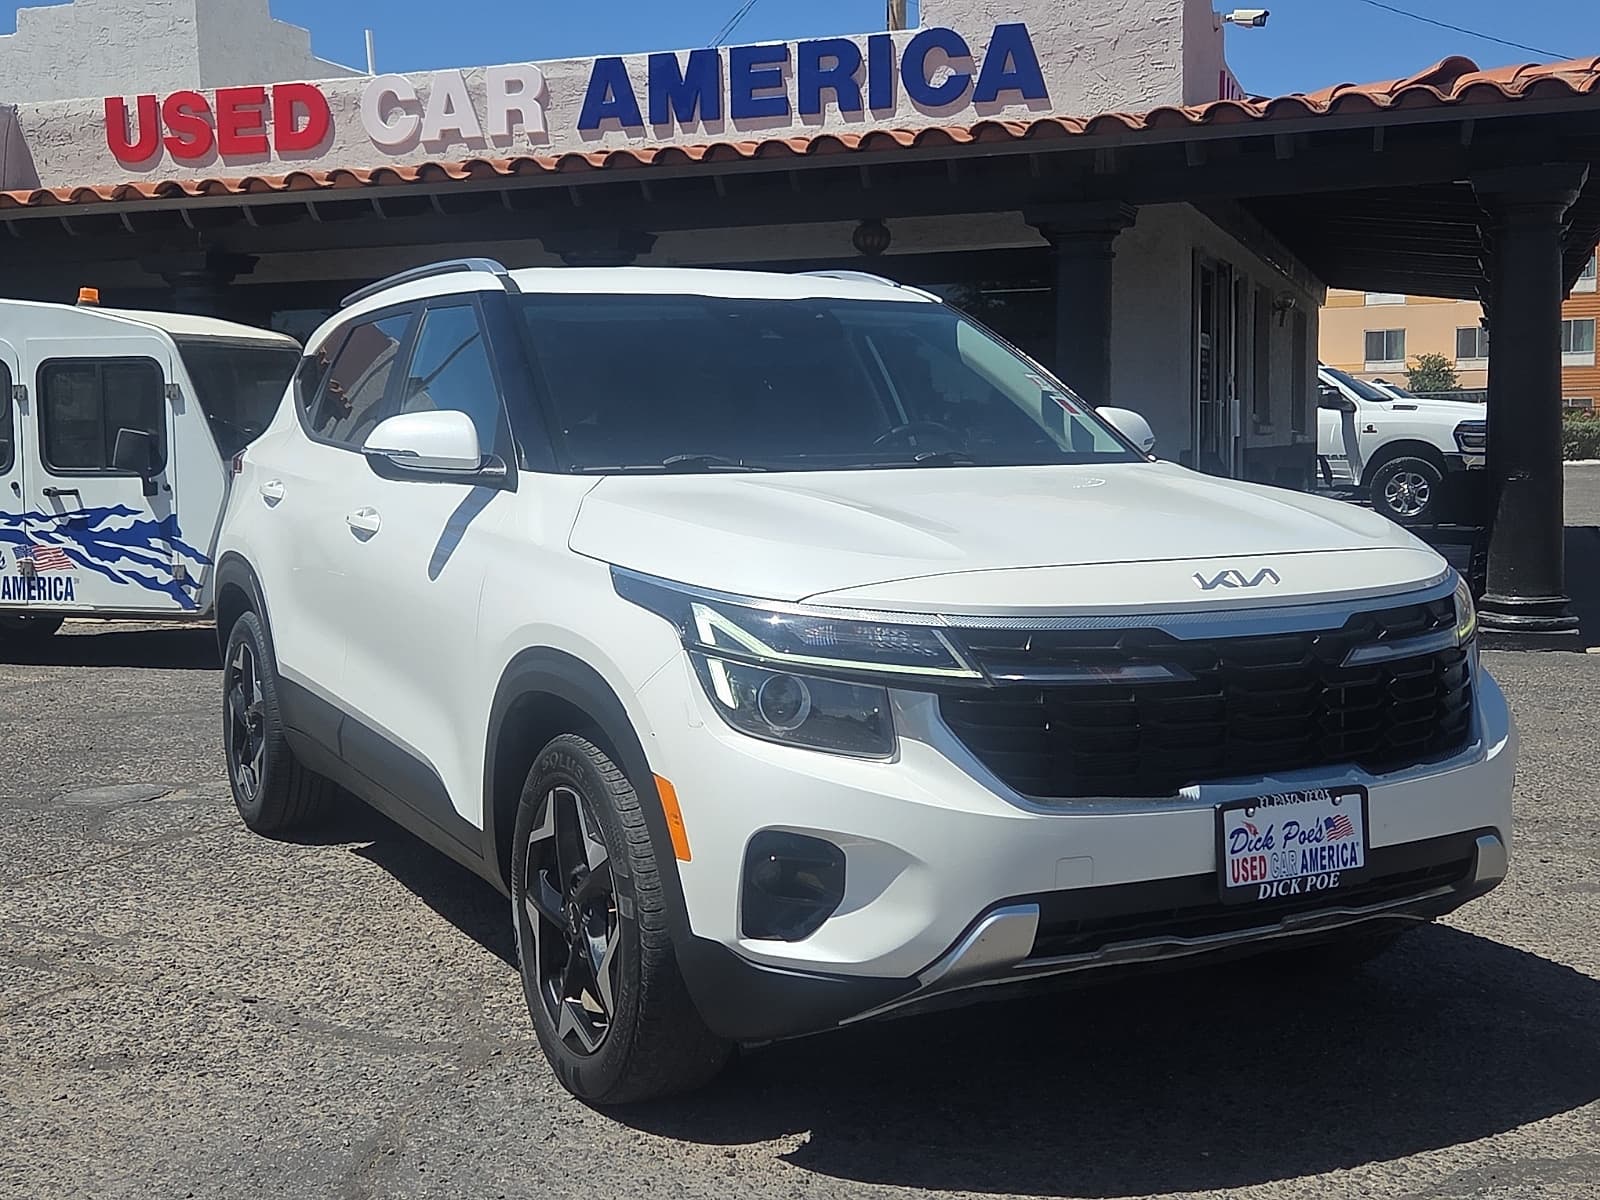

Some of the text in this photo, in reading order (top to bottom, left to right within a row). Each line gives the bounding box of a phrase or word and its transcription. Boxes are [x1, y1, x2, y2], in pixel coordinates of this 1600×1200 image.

[105, 23, 1048, 164] USED CAR AMERICA
[1, 576, 75, 601] AMERICA
[1192, 567, 1281, 590] KIA
[1229, 816, 1325, 855] Dick Poe's
[1231, 842, 1358, 883] USED CAR AMERICA
[1257, 872, 1340, 899] DICK POE
